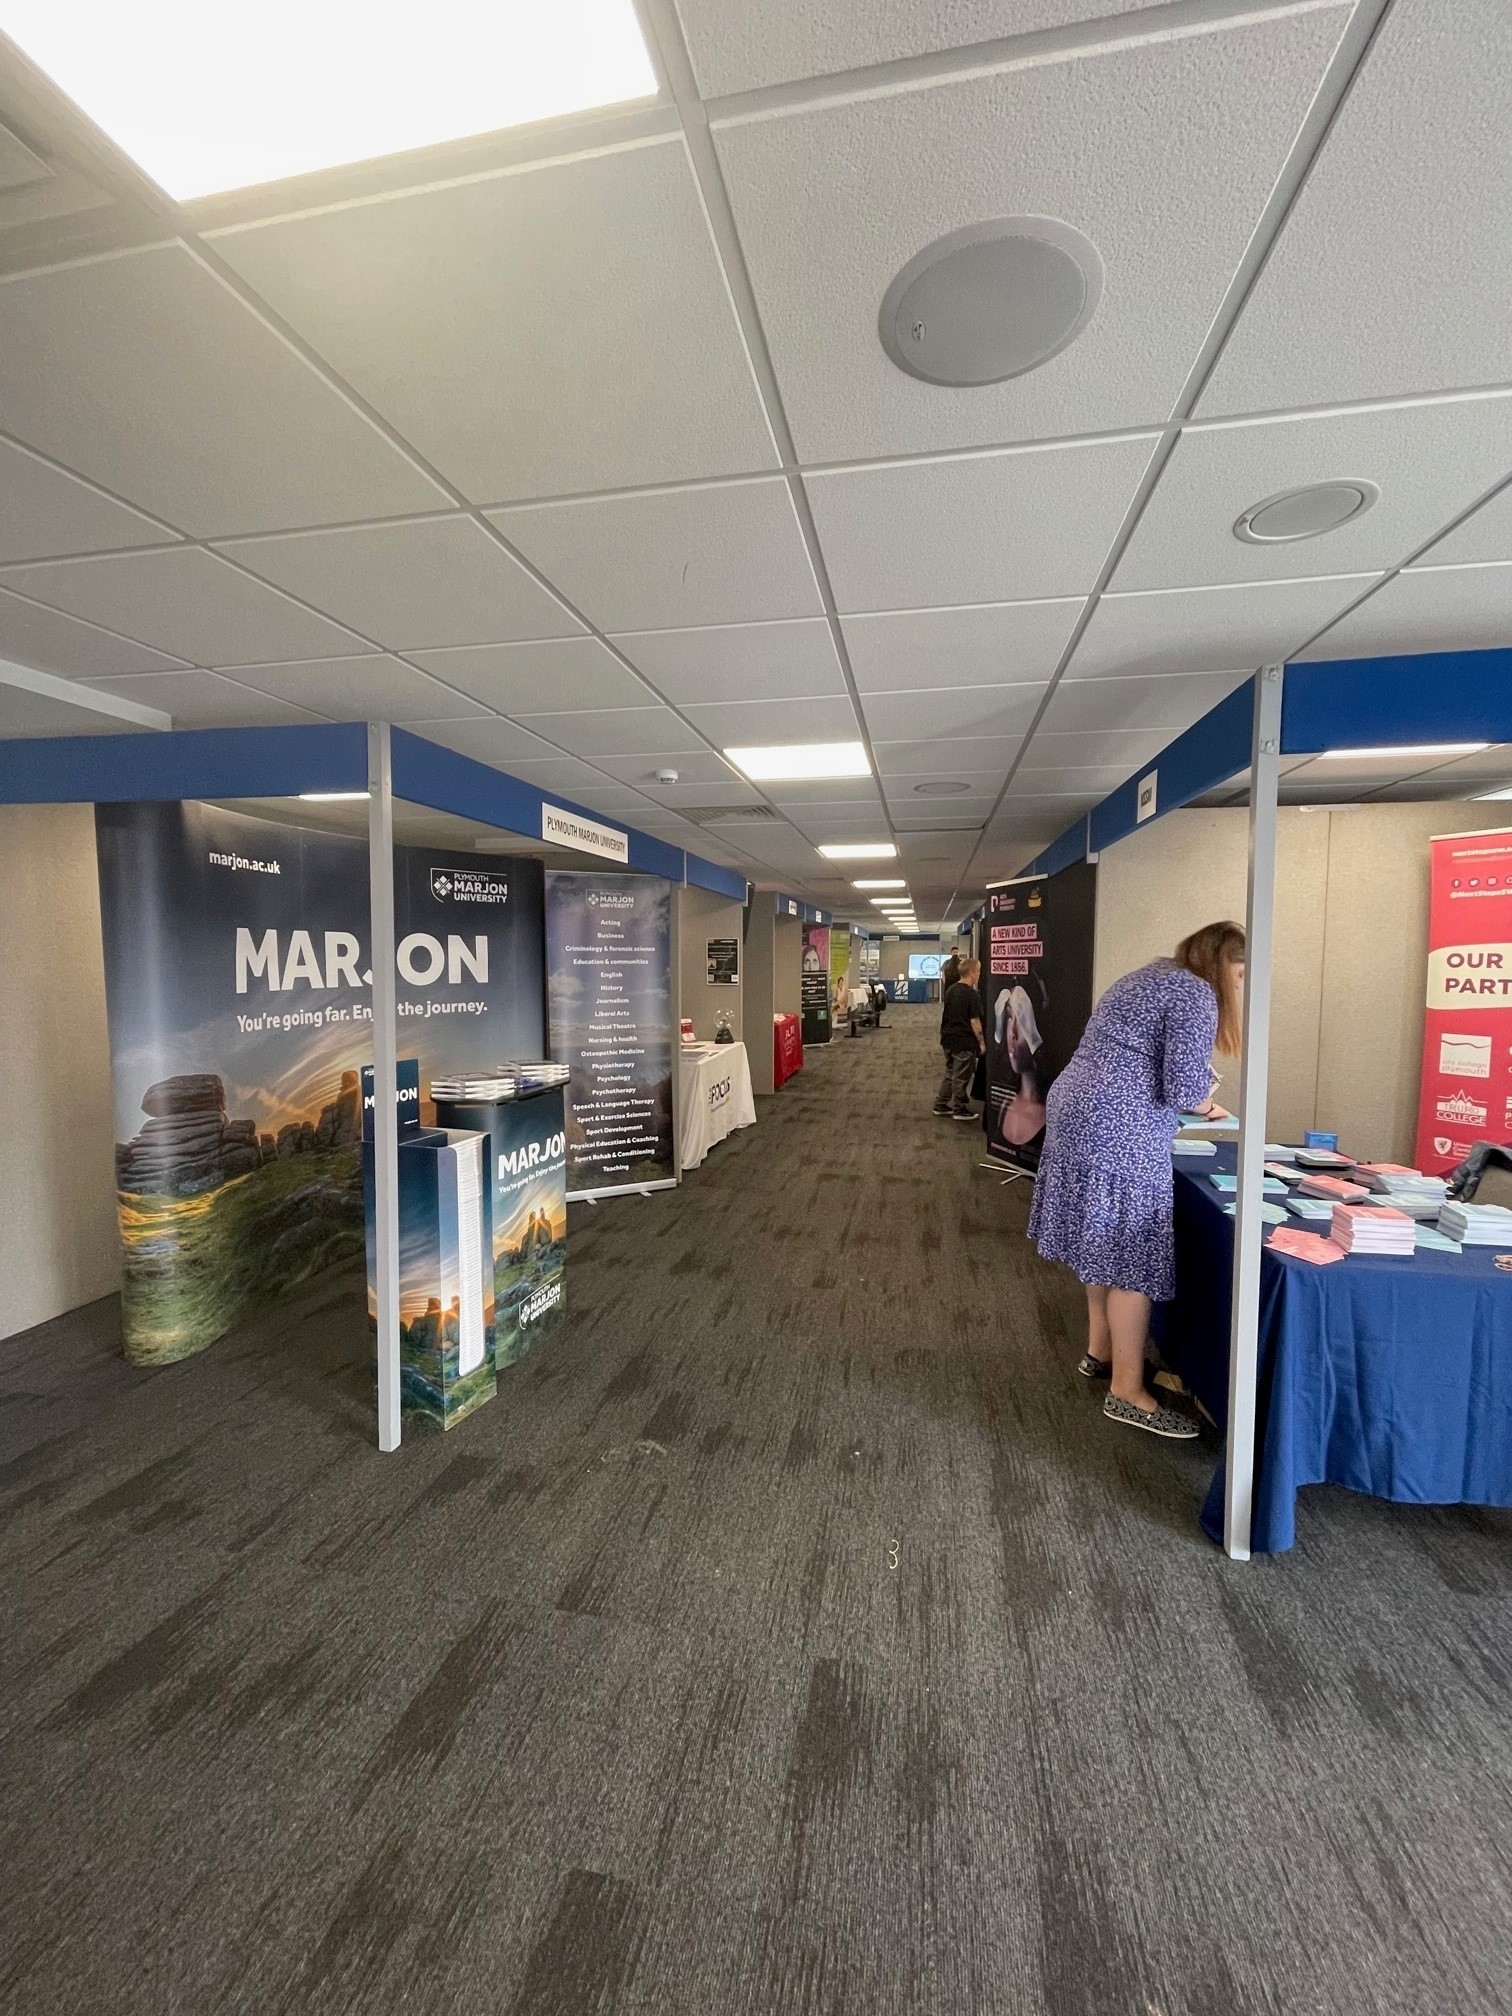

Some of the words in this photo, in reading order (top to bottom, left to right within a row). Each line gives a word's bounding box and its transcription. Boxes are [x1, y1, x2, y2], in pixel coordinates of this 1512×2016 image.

[547, 816, 577, 838] PLYMOUTH
[578, 827, 600, 845] MARJON
[600, 835, 626, 853] UNIVERSITY
[209, 850, 281, 875] marjon.ac.uk
[454, 872, 489, 882] PLYMOUTH
[454, 880, 508, 895] MARJON
[454, 892, 508, 903] UNIVERSITY
[600, 895, 635, 904] MARJON
[600, 919, 621, 927] Acting
[992, 929, 997, 939] A
[997, 928, 1010, 938] NEW
[1011, 927, 1026, 938] KIND
[1027, 925, 1036, 936] OF
[992, 945, 1006, 955] ARTS
[1008, 943, 1042, 955] UNIVERSITY
[236, 927, 490, 994] MARON
[1446, 952, 1504, 969] OUR
[992, 962, 1009, 972] SINCE
[600, 971, 623, 979] English
[600, 984, 624, 992] History
[1445, 977, 1512, 995] PART
[397, 1002, 424, 1017] the
[424, 1001, 488, 1018] journey.
[237, 1013, 280, 1033] You're
[282, 1009, 323, 1031] going
[325, 1006, 350, 1023] far.
[580, 1049, 618, 1057] Osteopathic
[591, 1062, 635, 1070] Physiotherapy
[1442, 1065, 1487, 1075] plymouth
[597, 1075, 631, 1083] Psychology
[591, 1087, 637, 1096] Psychotherapy
[364, 1086, 418, 1110] MJON
[572, 1102, 595, 1111] Speech
[600, 1101, 630, 1109] Language
[577, 1116, 594, 1124] Sport
[600, 1113, 626, 1121] Exercise
[1436, 1111, 1487, 1125] COLLEGE
[586, 1128, 603, 1136] Sport
[604, 1124, 643, 1133] Development
[569, 1142, 596, 1151] Physical
[596, 1139, 626, 1147] Education
[631, 1135, 659, 1143] Coaching
[574, 1155, 592, 1163] Sport
[592, 1152, 612, 1160] Rehab
[617, 1148, 656, 1157] Conditioning
[602, 1164, 630, 1172] Teaching
[530, 1282, 561, 1314] MARJON
[530, 1293, 561, 1321] UNIVERSITY
